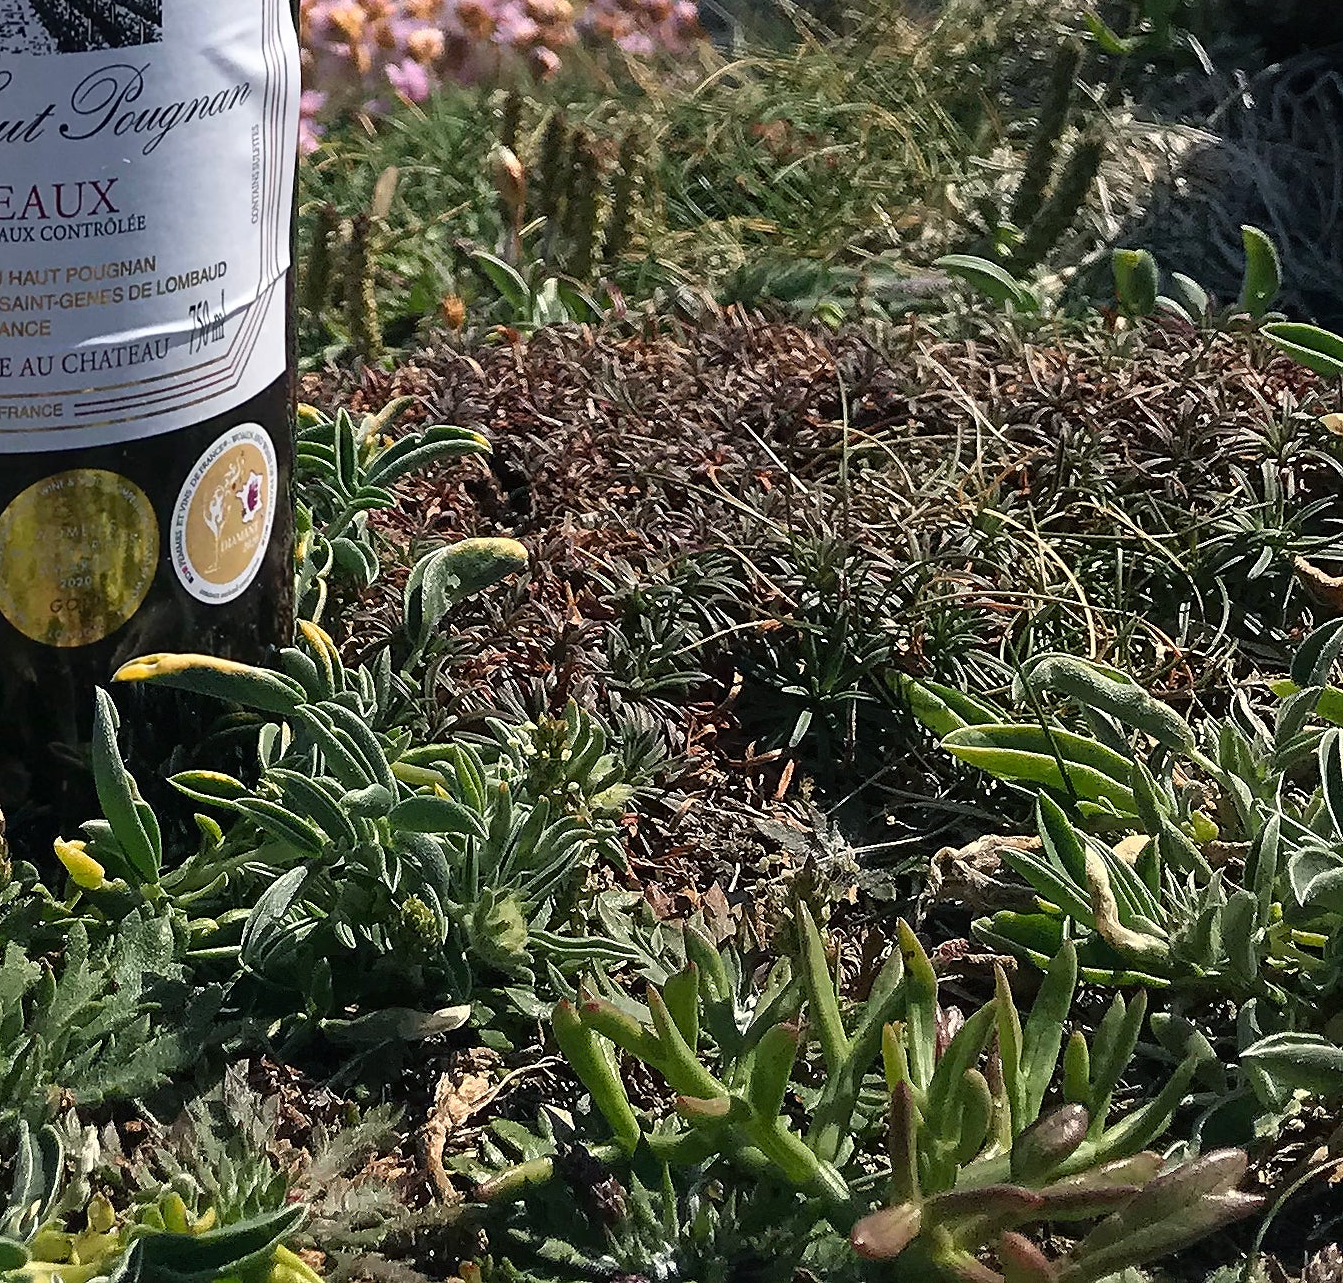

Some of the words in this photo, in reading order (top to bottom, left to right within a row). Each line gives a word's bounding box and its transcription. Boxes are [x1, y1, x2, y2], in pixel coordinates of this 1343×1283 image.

[58, 62, 252, 155] Pougnan
[251, 170, 260, 224] CONTAINS
[40, 213, 146, 241] CONTRÔLÉE
[9, 267, 61, 287] HAUT
[66, 255, 157, 284] POUGNAN
[129, 282, 153, 301] DE
[157, 261, 227, 295] LOMBAUD
[189, 299, 209, 355] 750
[19, 356, 54, 377] AU
[61, 338, 170, 374] CHATEAU
[179, 489, 193, 512] VINS
[189, 472, 201, 487] DE
[60, 574, 93, 589] 2020
